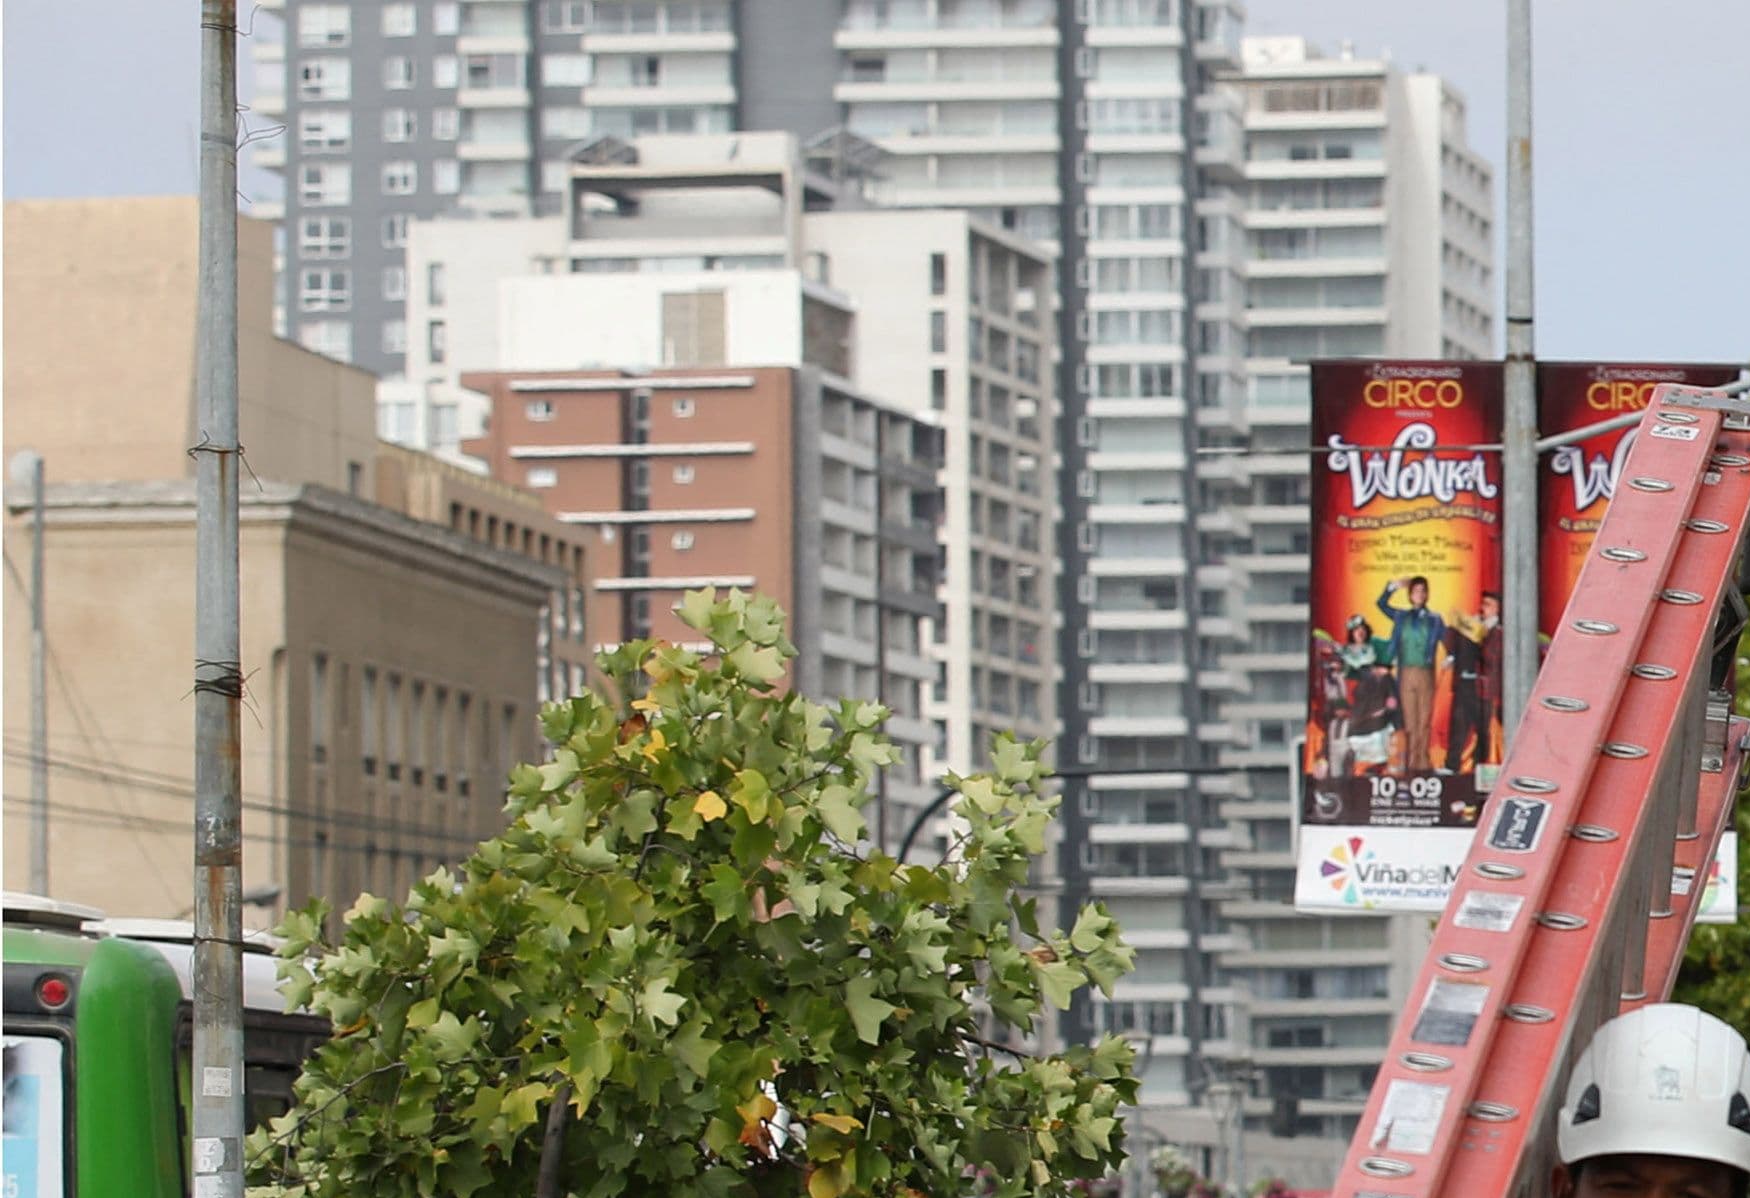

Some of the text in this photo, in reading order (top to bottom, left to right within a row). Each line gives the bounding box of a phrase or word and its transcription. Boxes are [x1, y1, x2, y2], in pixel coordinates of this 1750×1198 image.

[1363, 380, 1463, 408] CIRCO
[1370, 777, 1443, 798] 10 09
